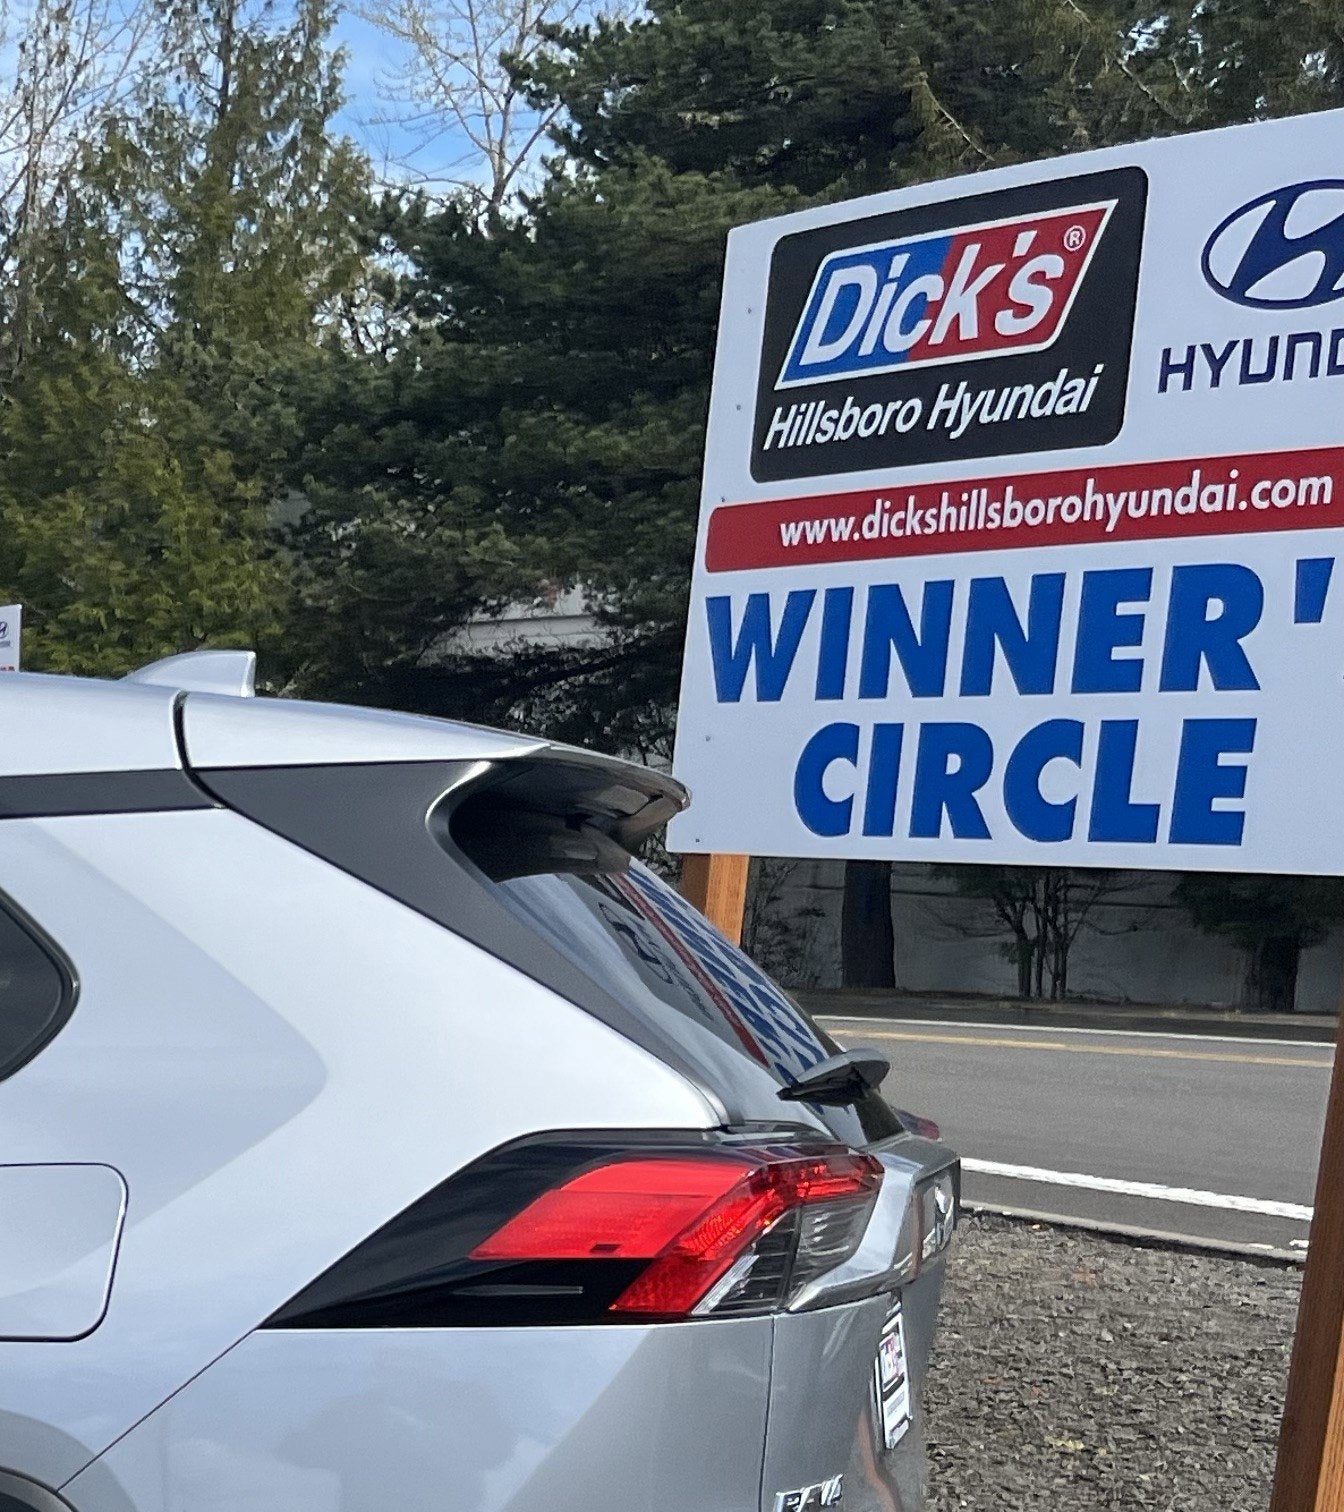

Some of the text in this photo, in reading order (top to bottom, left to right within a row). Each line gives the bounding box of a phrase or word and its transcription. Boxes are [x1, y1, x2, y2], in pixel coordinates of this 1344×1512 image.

[799, 229, 1066, 366] Dick's
[763, 363, 1105, 451] Hillsboro Hyundai
[779, 467, 1334, 548] www.dickshillsborohyundai.com
[705, 556, 1344, 704] WINNER'
[793, 717, 1259, 847] CIRCLE
